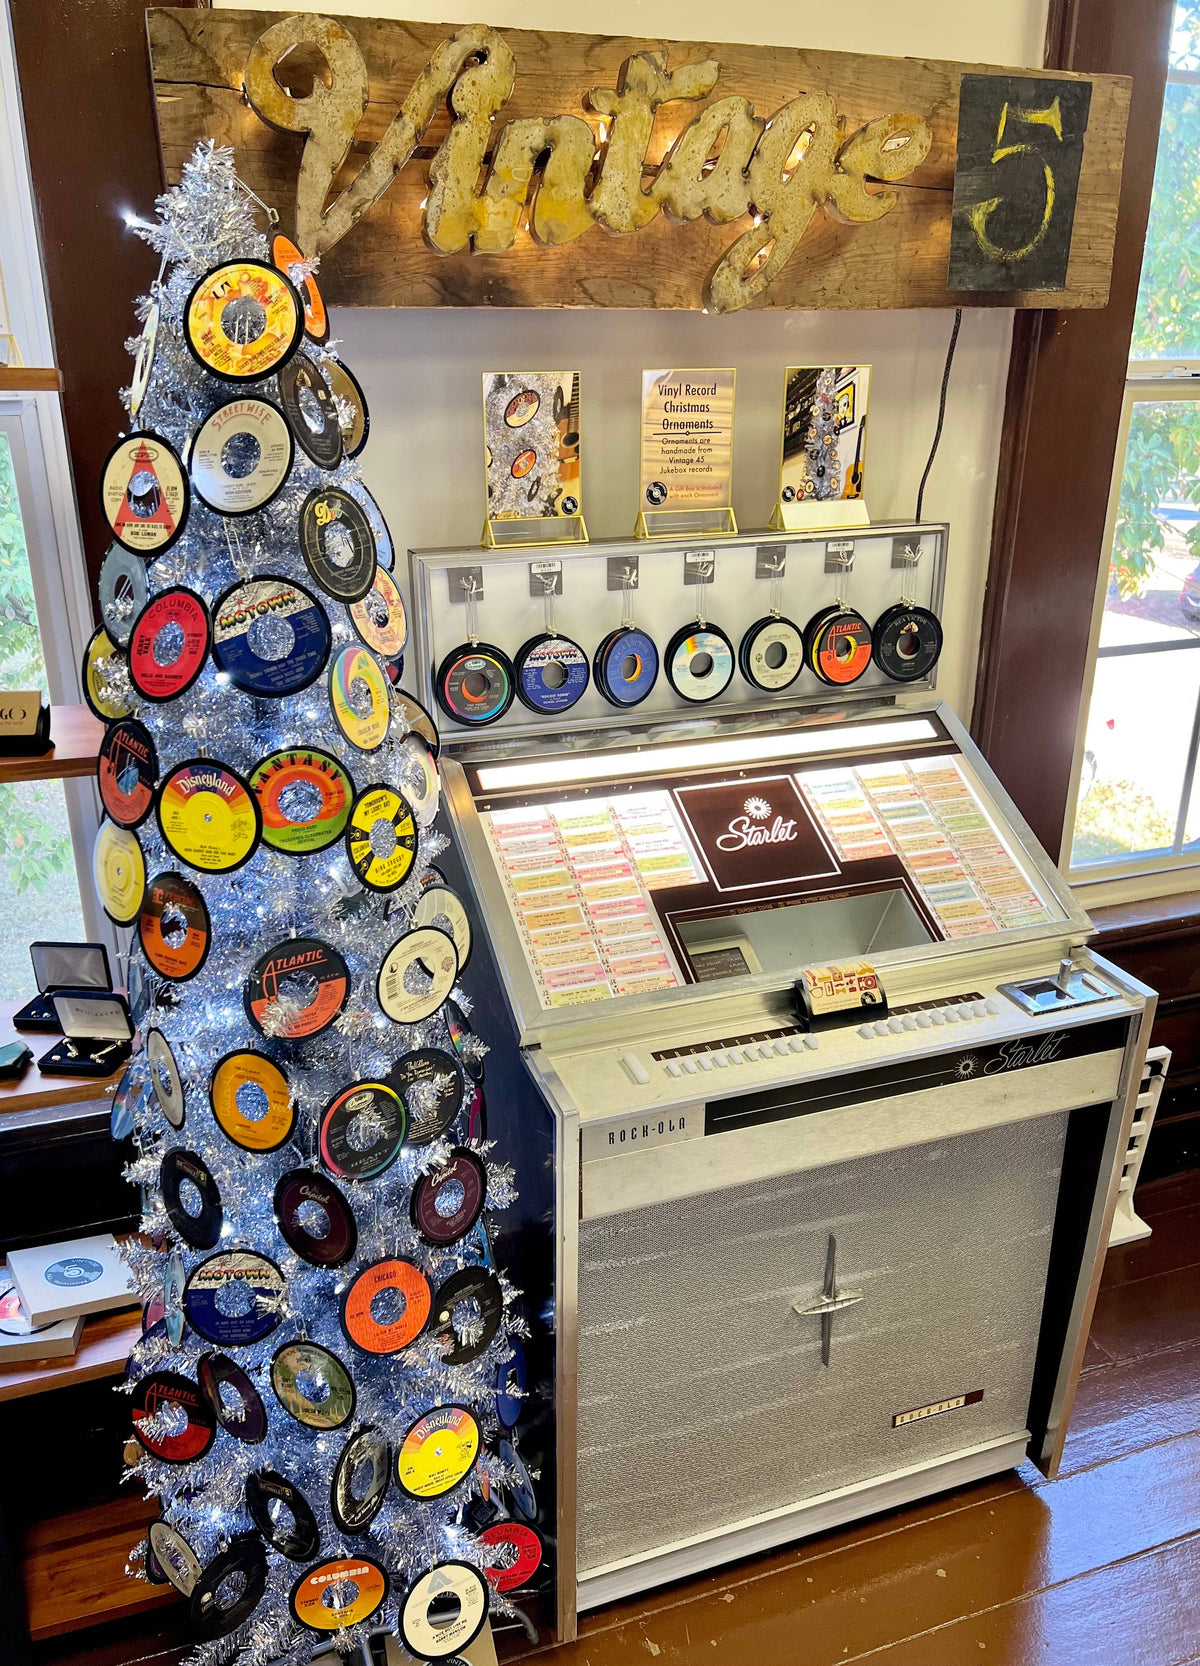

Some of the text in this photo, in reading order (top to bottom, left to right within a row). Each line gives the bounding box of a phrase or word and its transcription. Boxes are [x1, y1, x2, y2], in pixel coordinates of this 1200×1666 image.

[244, 13, 1064, 314] Vintage 5
[658, 383, 717, 398] Vinyl Record
[664, 401, 710, 413] Christmas
[662, 418, 714, 430] Ornaments
[661, 447, 696, 455] handmade
[668, 457, 694, 466] Vintage
[315, 499, 342, 526] Dot
[148, 598, 199, 622] COLUMBIA
[220, 590, 296, 631] MOTOWN
[826, 622, 862, 646] ATLANTIC
[529, 650, 578, 662] MOTOWN
[110, 729, 150, 768] ATLANTIC
[176, 772, 236, 797] Disneyland
[252, 753, 343, 795] FANTASY
[364, 795, 388, 808] TOMORROW'S
[371, 806, 382, 814] LUCKY
[716, 816, 798, 852] Starlet
[375, 854, 404, 874] BING CROSBY
[262, 949, 324, 987] ATLANTIC
[984, 1030, 1070, 1076] Starlet
[608, 1116, 686, 1145] ROCK-OLA
[351, 1149, 389, 1167] HEART
[431, 1161, 458, 1187] Capitol
[300, 1185, 329, 1204] Capitol
[64, 1264, 85, 1279] 5
[199, 1269, 270, 1281] MOTOWN
[374, 1271, 397, 1284] CHICAGO
[146, 1382, 197, 1407] ATLANTIC
[414, 1412, 462, 1442] Disneyland
[310, 1566, 370, 1586] COLUMBIA
